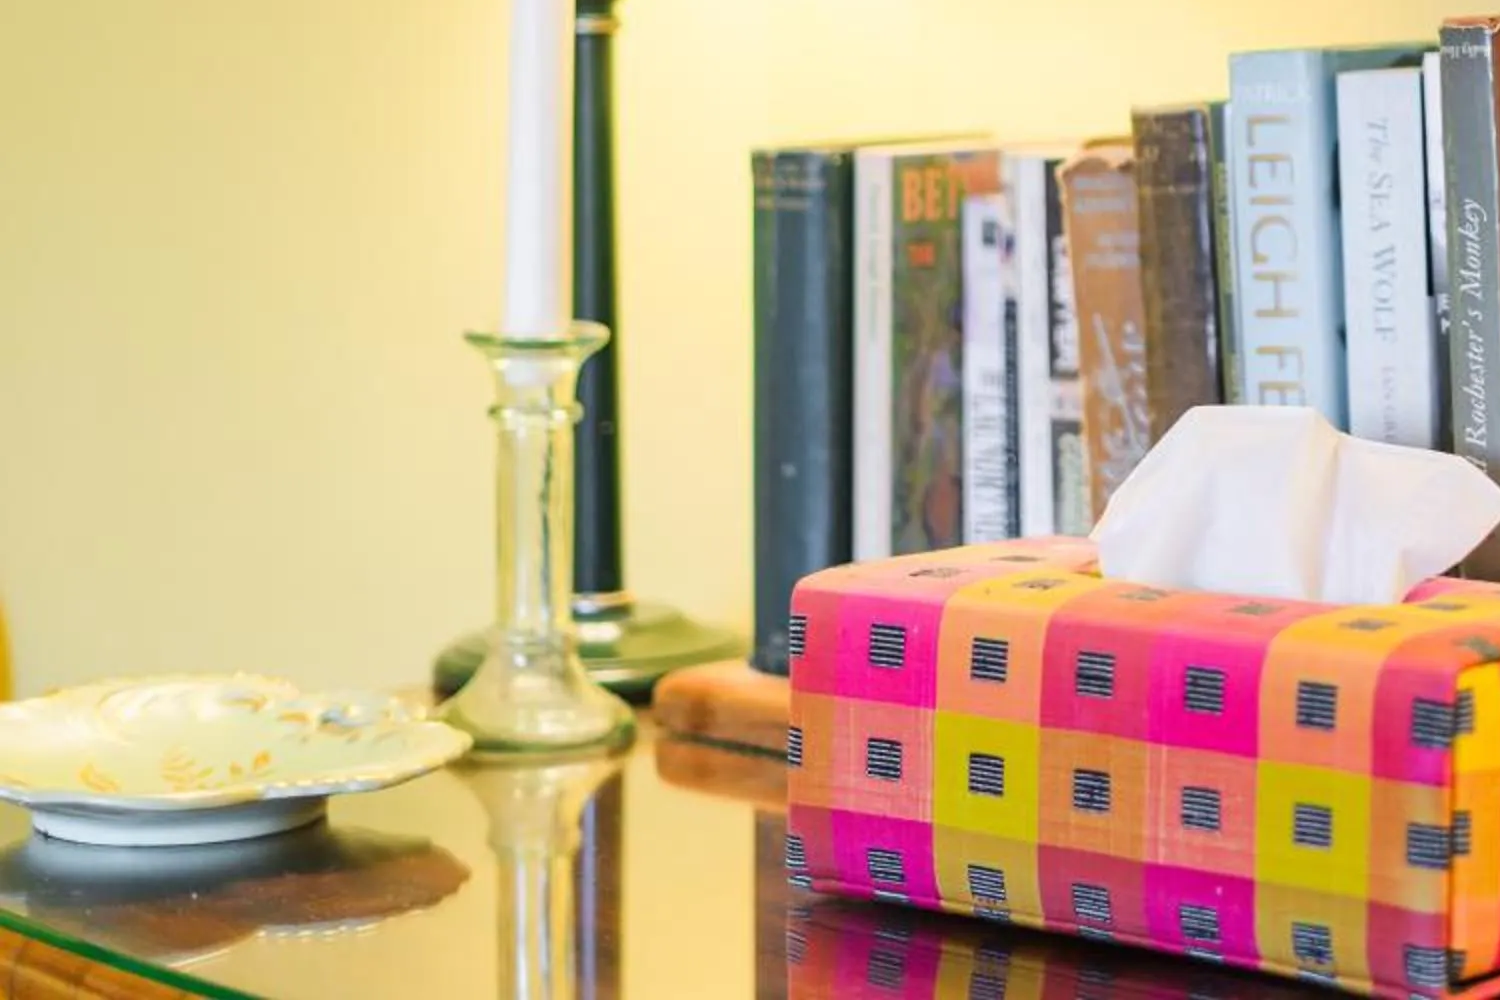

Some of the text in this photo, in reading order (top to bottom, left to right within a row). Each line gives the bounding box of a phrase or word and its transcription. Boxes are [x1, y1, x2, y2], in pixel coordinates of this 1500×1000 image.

[1366, 118, 1394, 164] The
[1245, 113, 1299, 319] LEIGH
[1366, 170, 1393, 233] SEA
[1457, 198, 1488, 299] Monkey
[1371, 243, 1398, 342] WOLF
[1460, 308, 1488, 446] Rochester's
